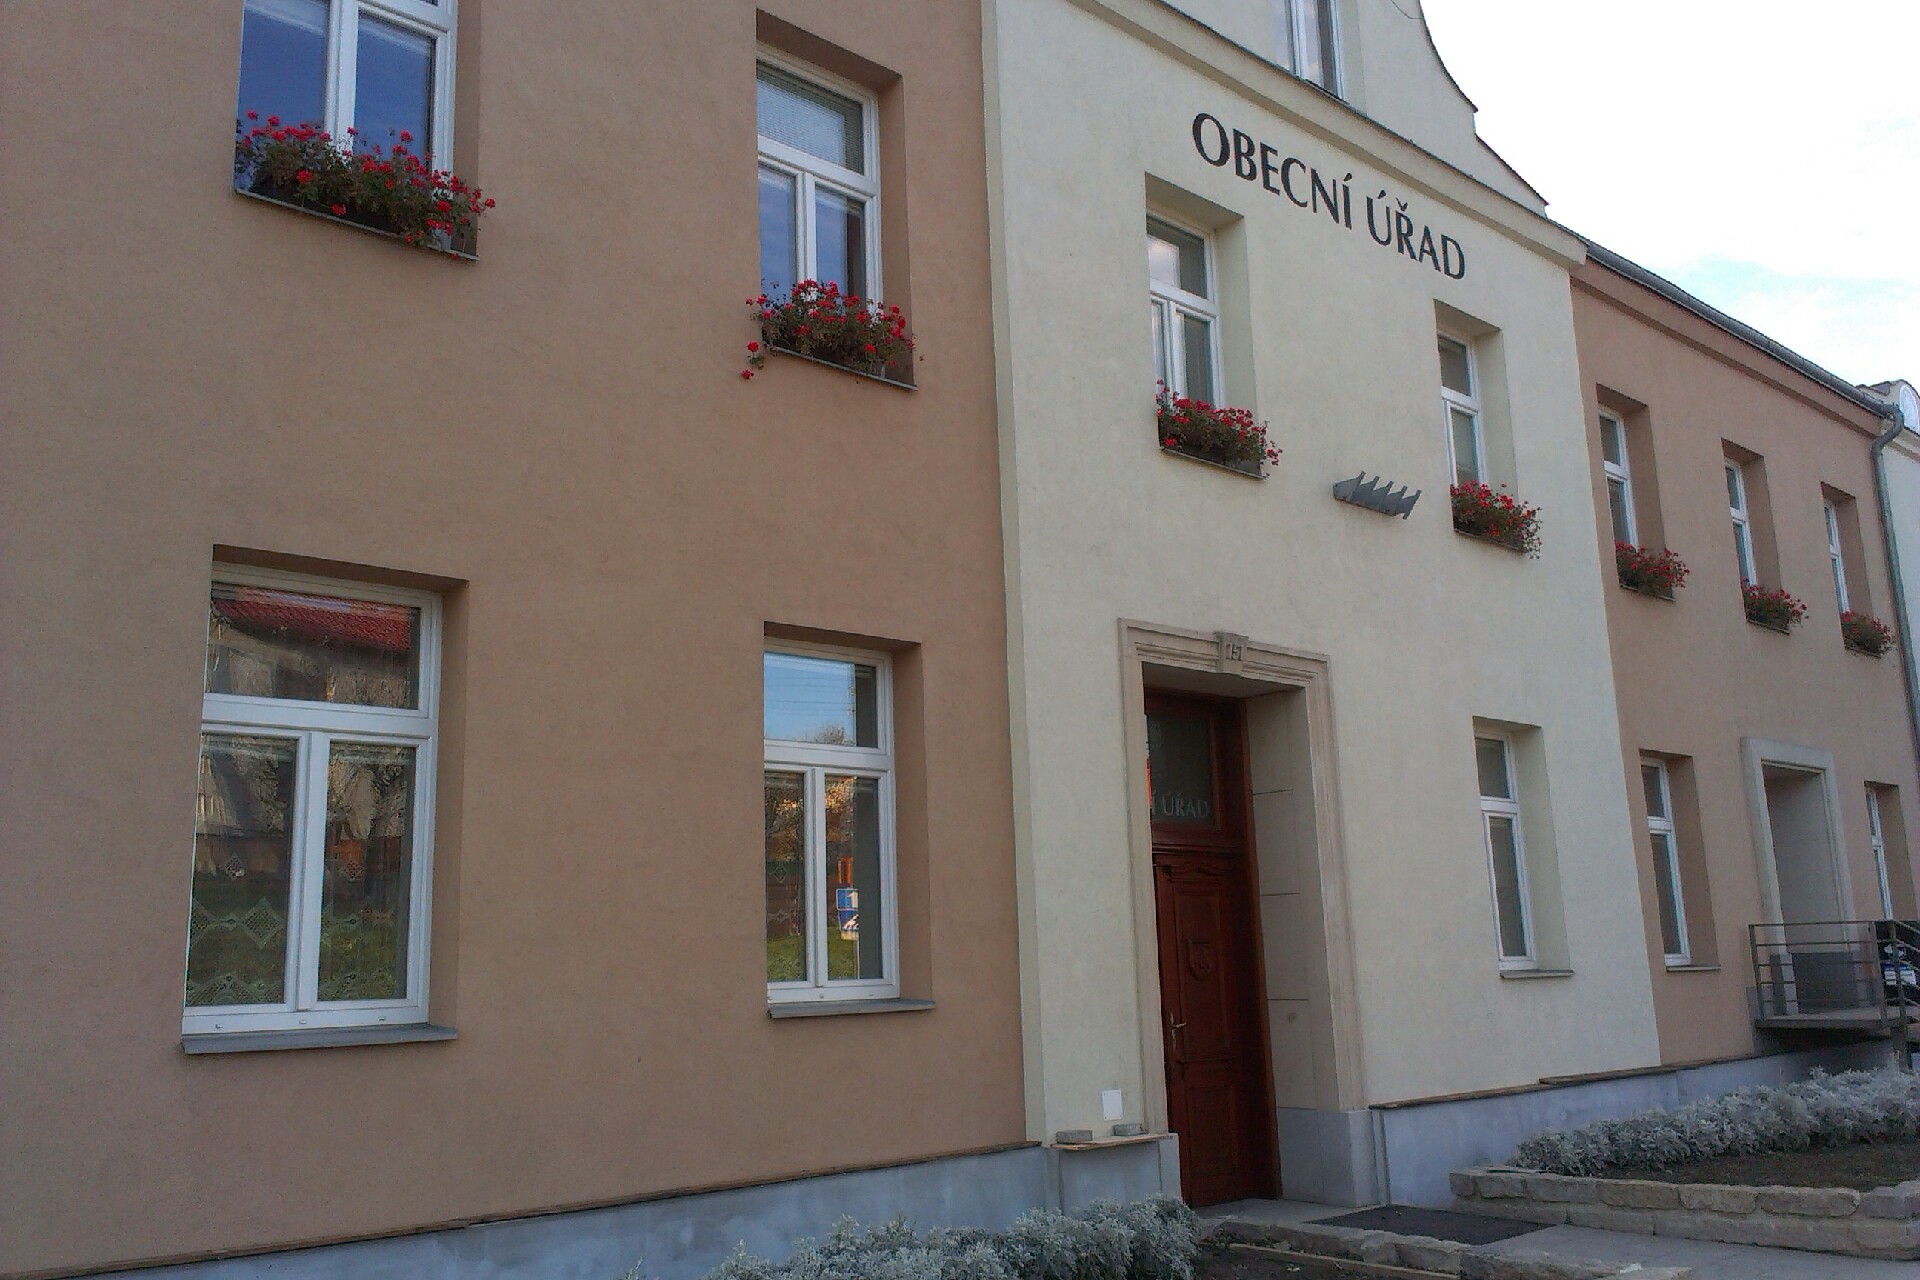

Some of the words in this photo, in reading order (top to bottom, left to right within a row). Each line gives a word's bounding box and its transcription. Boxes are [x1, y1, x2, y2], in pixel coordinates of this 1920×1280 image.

[1191, 112, 1353, 230] OBECNÍ
[1366, 189, 1466, 280] ÚŘAD
[1162, 791, 1209, 818] ÚŘAD
